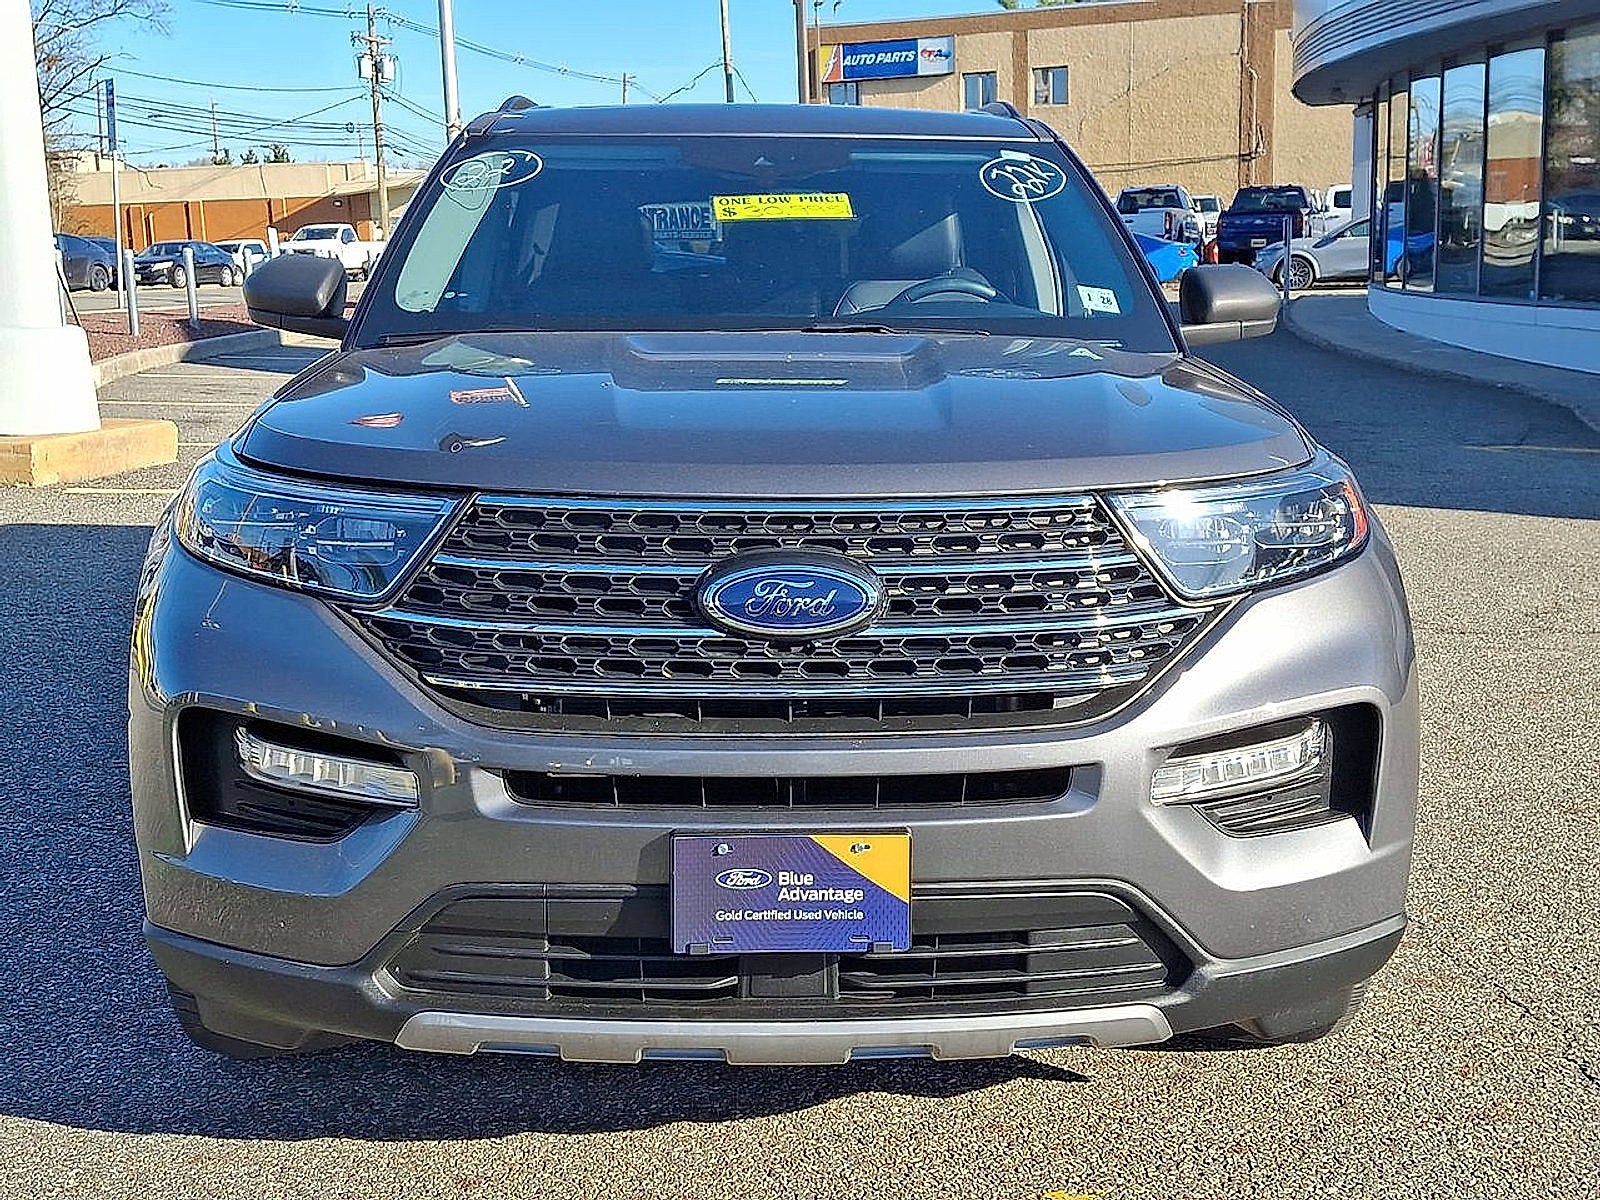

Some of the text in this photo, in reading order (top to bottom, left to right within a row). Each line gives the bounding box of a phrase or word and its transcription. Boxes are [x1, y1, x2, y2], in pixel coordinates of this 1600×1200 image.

[843, 53, 876, 66] AUTO
[876, 51, 917, 64] PARTS
[719, 195, 845, 206] ONE LOW PRICE
[745, 579, 838, 617] Ford
[726, 871, 814, 886] Ford Blue
[777, 887, 864, 903] Advantage
[715, 909, 864, 921] Gold Certified Used Vehicle
